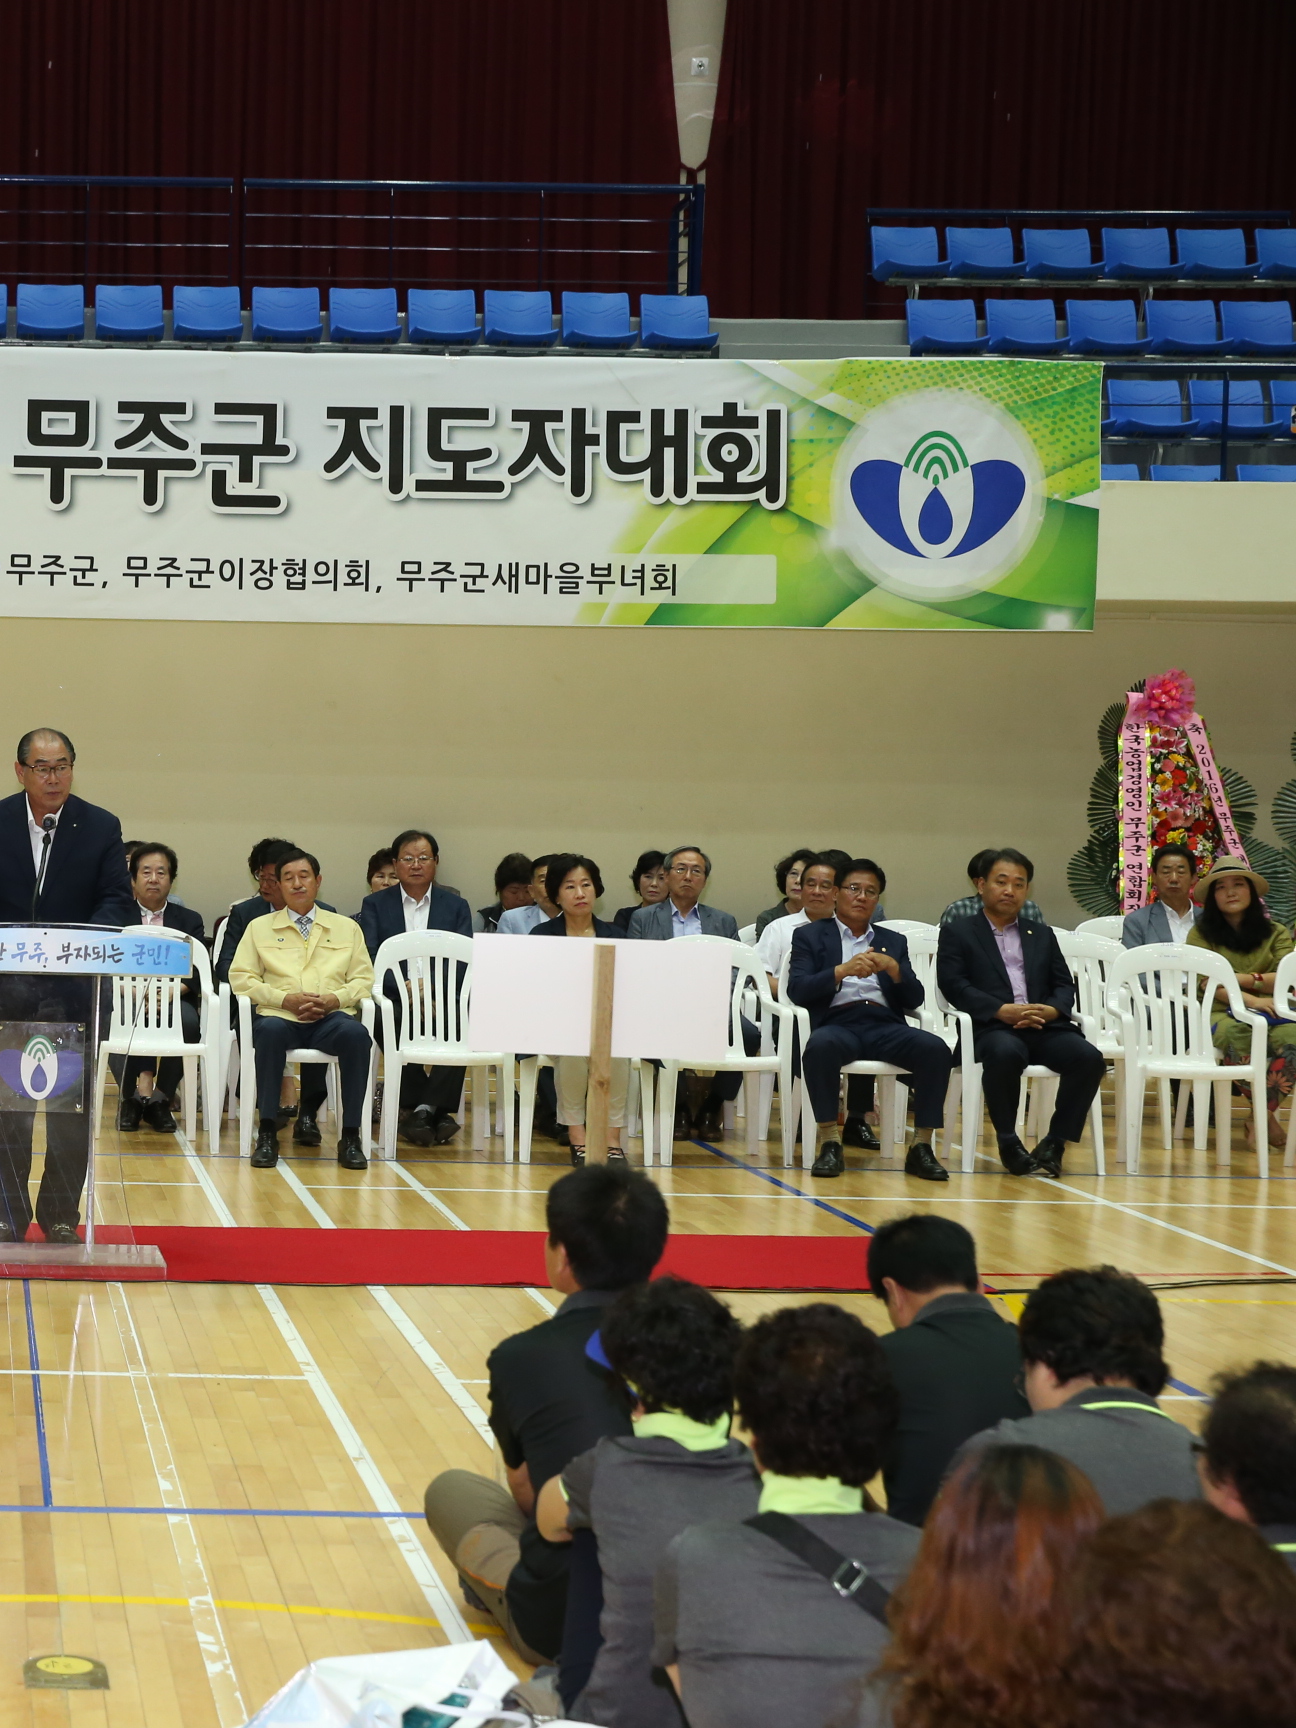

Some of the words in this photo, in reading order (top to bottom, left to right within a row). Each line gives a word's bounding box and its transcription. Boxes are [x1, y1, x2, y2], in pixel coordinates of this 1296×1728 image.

[13, 399, 291, 509] 무주군
[323, 402, 783, 504] 지도자대회
[5, 553, 108, 589] 무주군,
[122, 556, 382, 594] 무주군이장협의회,
[396, 560, 677, 597] 무주군새마을부녀회
[1124, 722, 1145, 812] 한국농업경영인
[1196, 744, 1224, 807] 2016년
[1218, 812, 1241, 850] 무주군
[1124, 817, 1146, 857] 무주군
[11, 942, 49, 965] 무주,
[56, 942, 125, 965] 부자되는
[131, 943, 171, 966] 군민!
